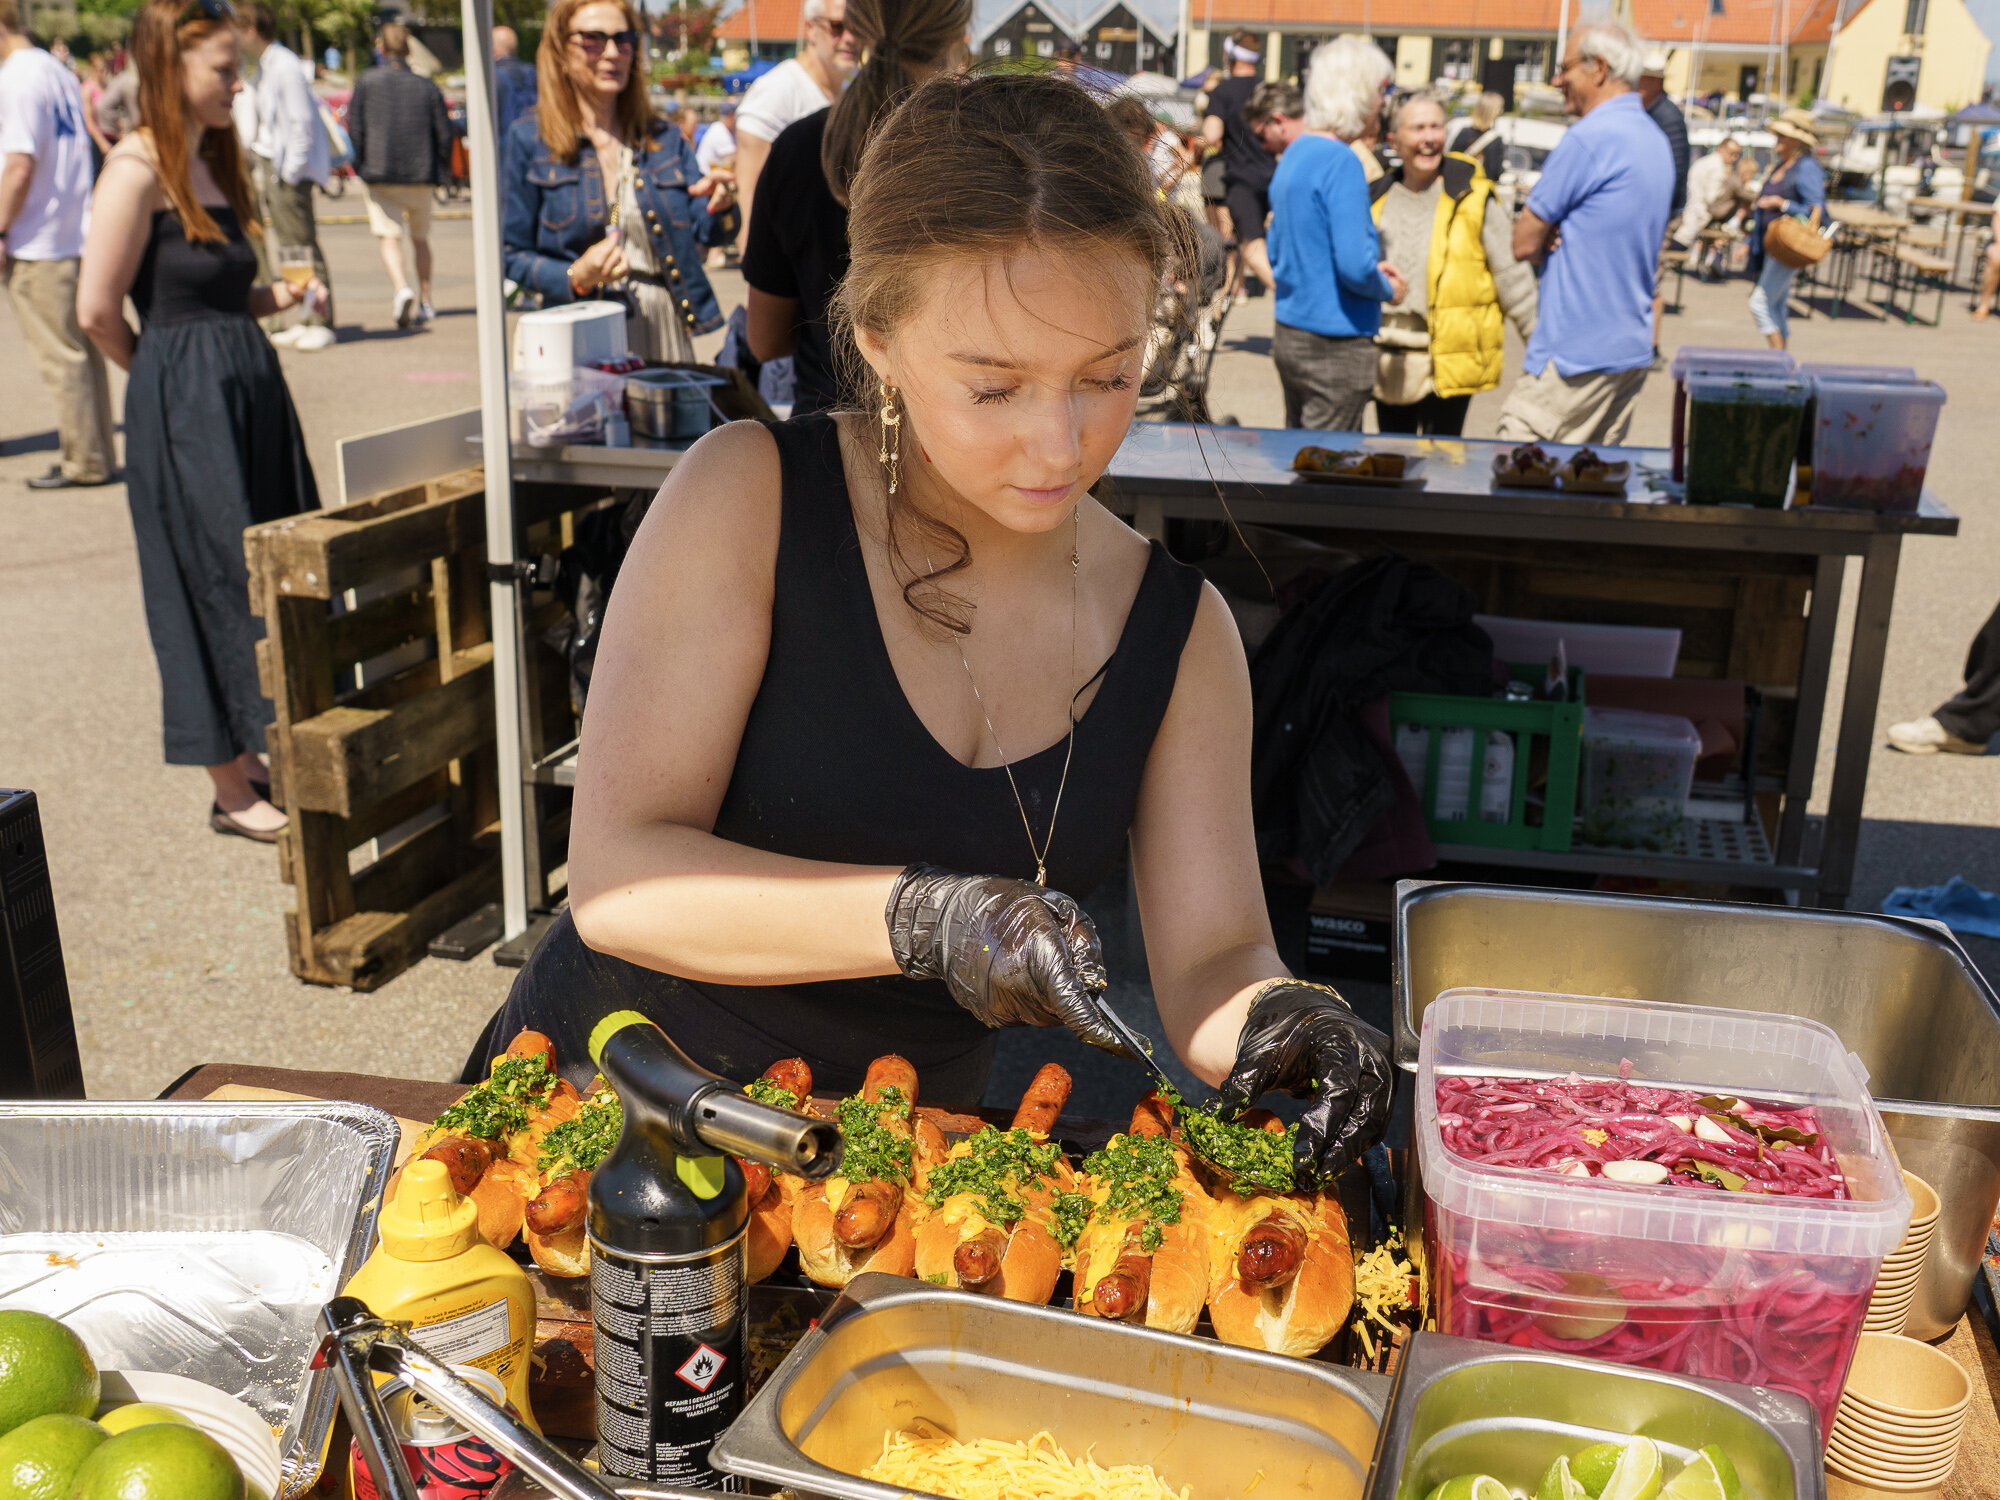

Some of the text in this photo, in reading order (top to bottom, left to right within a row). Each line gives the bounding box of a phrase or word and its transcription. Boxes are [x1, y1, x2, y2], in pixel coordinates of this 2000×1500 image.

[664, 1382, 734, 1407] GEFAHR GEVAAR DANGER
[672, 1392, 729, 1413] PERIGO PELIGRO FARE
[707, 1404, 719, 1413] FARA
